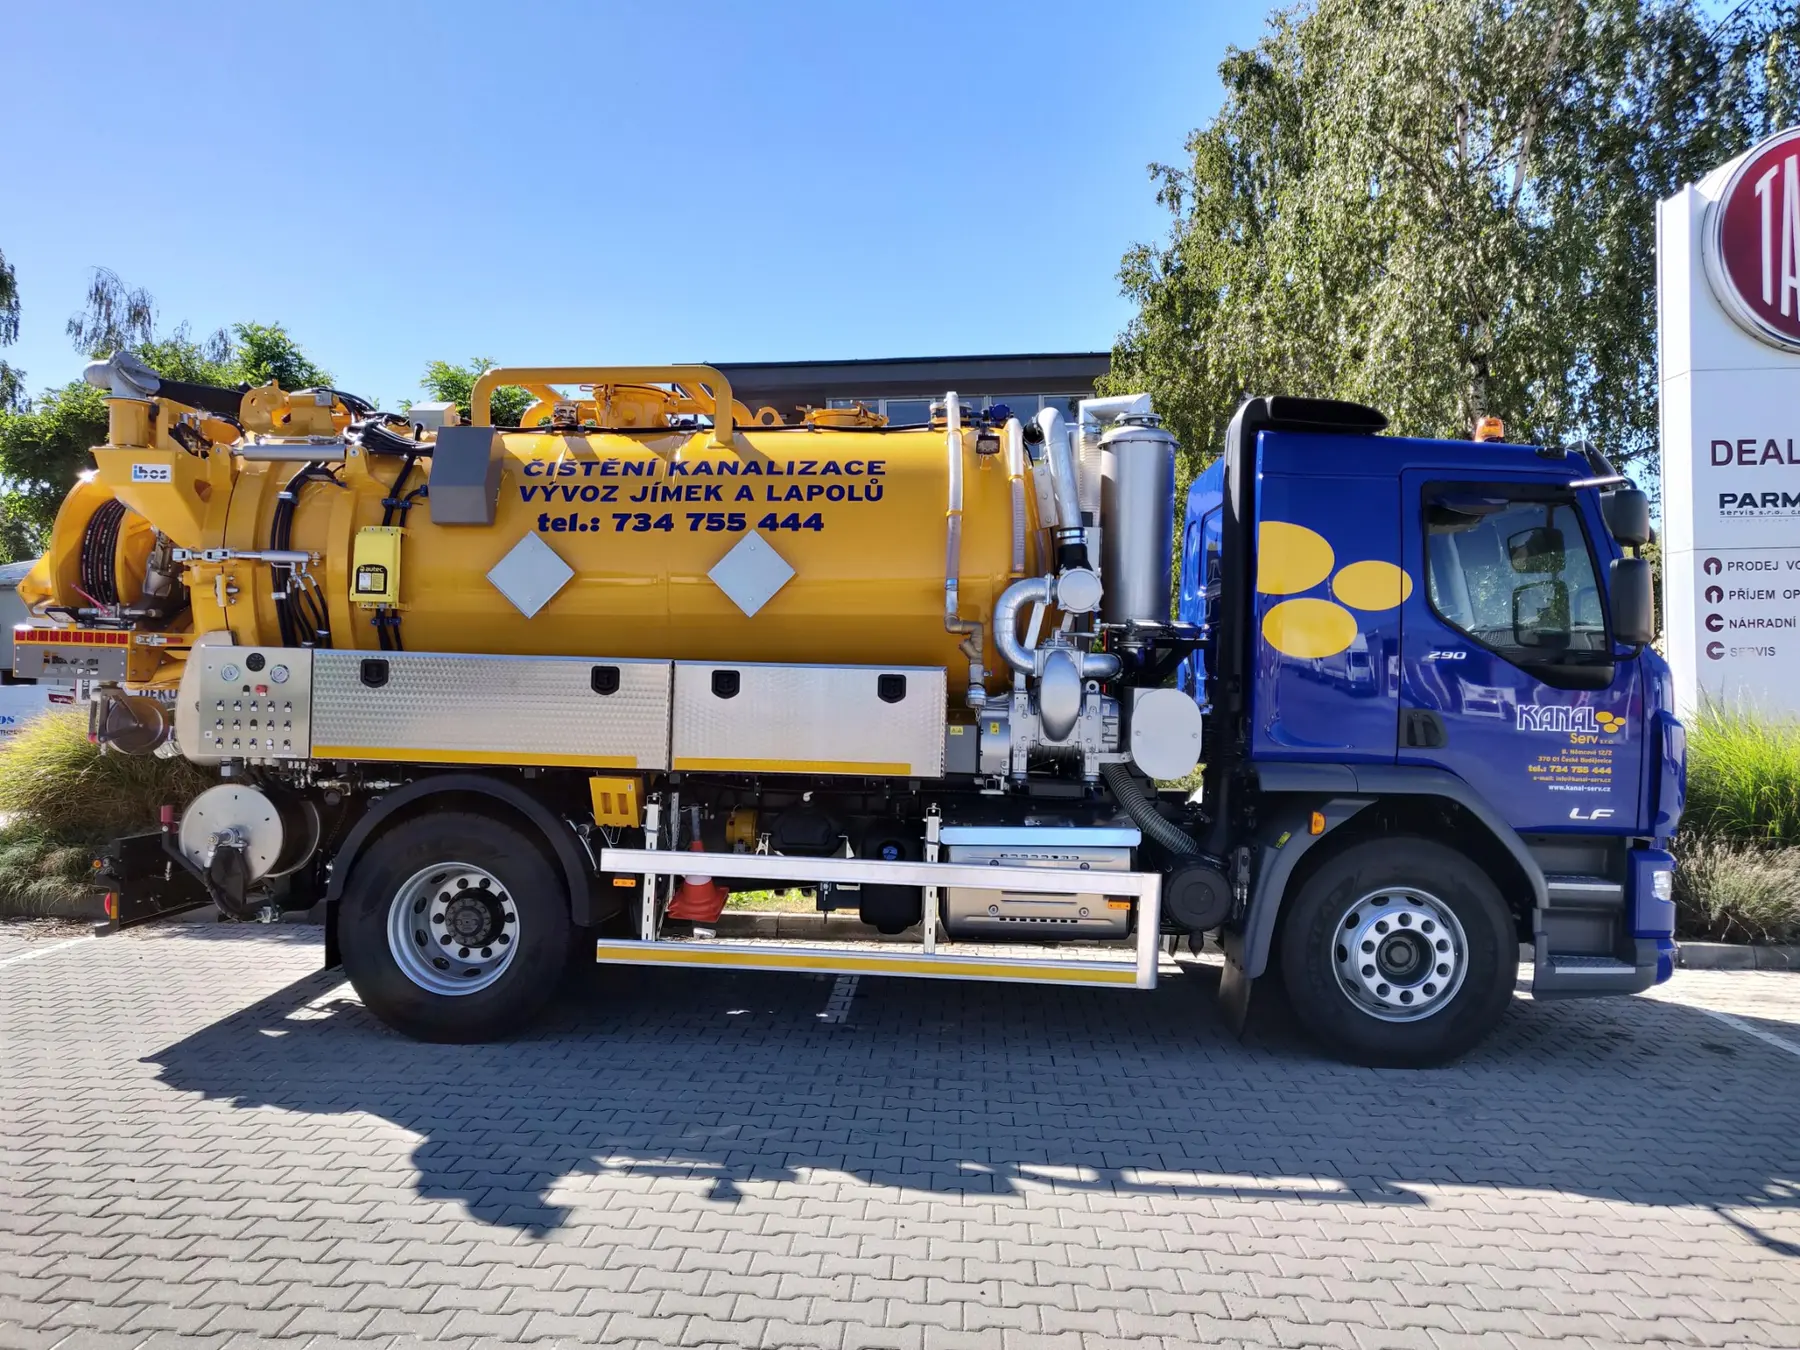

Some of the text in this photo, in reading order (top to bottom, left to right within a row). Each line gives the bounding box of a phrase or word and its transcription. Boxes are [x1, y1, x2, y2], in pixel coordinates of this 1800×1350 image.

[1711, 439, 1800, 466] DEAL
[523, 458, 886, 477] ČIŠTĚNÍ KANALIZACE
[519, 478, 883, 502] VÝVOZ JÍMEK A LAPOLŮ
[1719, 492, 1800, 509] PARM
[537, 512, 824, 532] tel.: 734 755 444
[1727, 561, 1779, 571] PRODEJ
[1729, 588, 1800, 600] PŘÍJEM OP
[1729, 616, 1796, 629] NÁHRADNÍ
[1428, 651, 1467, 660] 290
[1516, 705, 1599, 732] KANAL
[1570, 733, 1598, 744] Serv
[1569, 808, 1615, 820] LF
